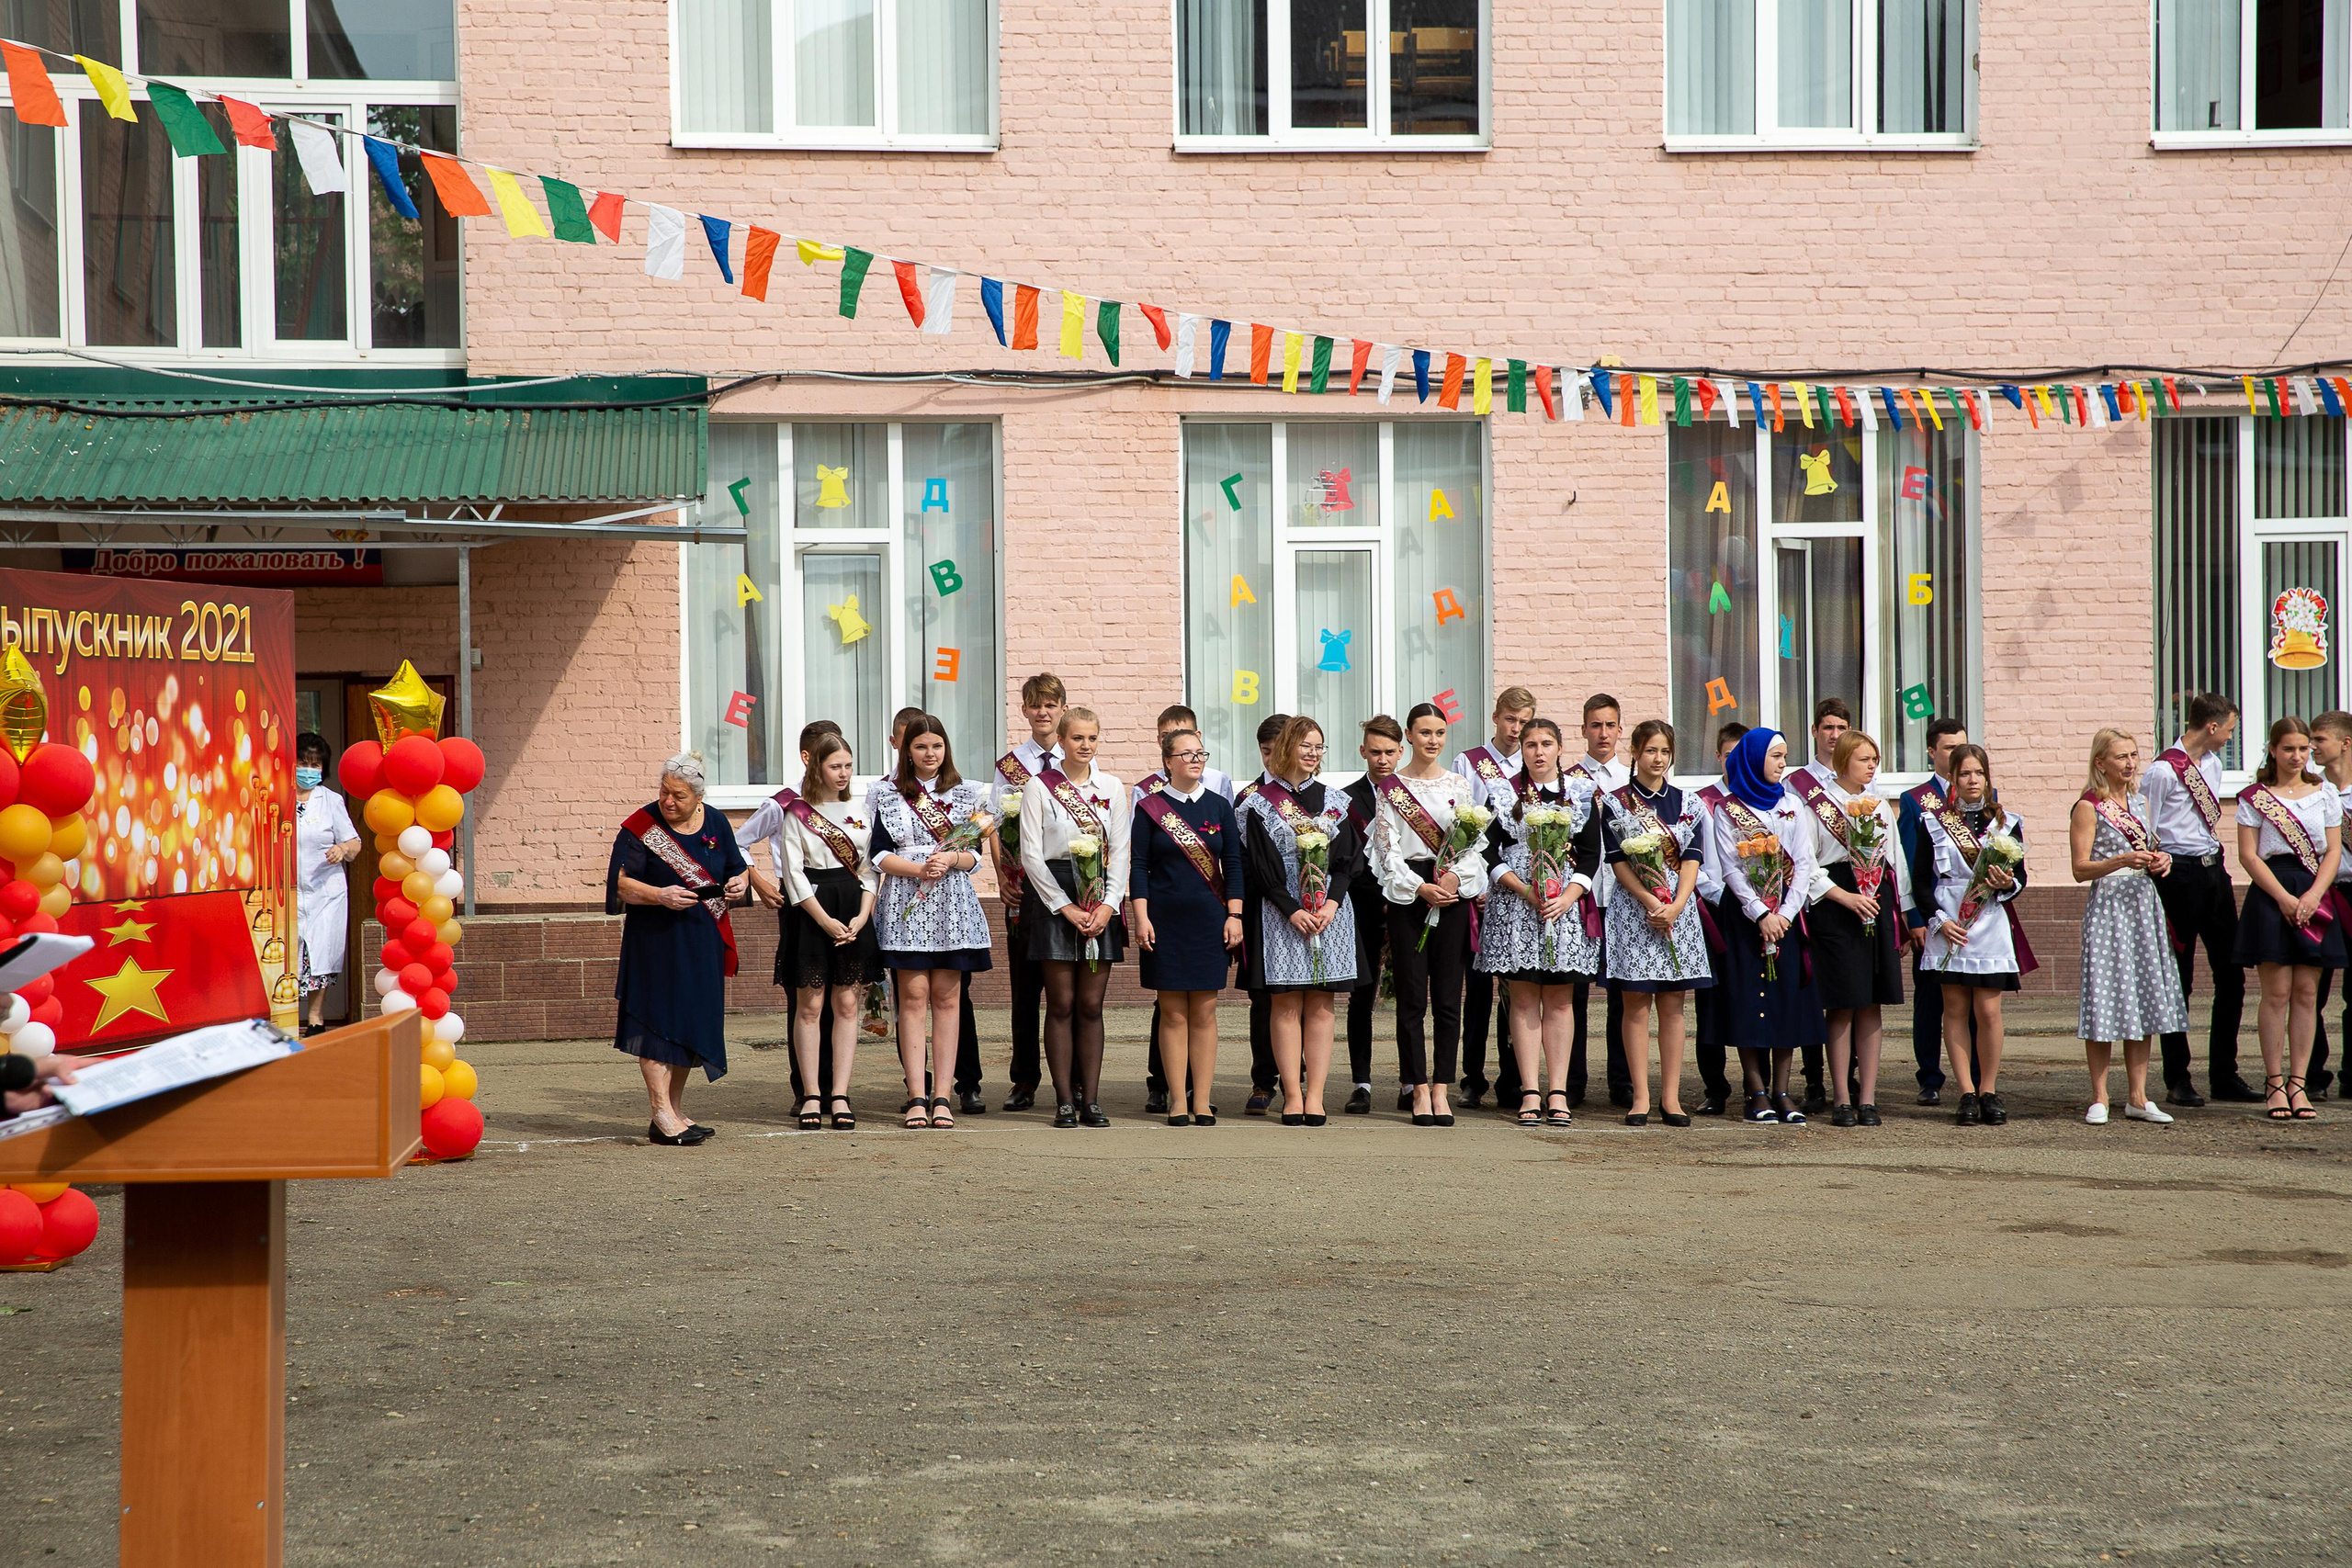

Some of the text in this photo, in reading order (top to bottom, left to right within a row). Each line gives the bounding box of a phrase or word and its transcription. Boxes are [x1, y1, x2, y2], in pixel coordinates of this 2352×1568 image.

[728, 477, 752, 516] Г
[922, 478, 949, 513] Д
[1220, 472, 1244, 512] Г
[1704, 480, 1732, 513] А
[1901, 465, 1928, 501] Е
[1429, 488, 1455, 523] А
[92, 547, 367, 575] Добро пожаловать !
[929, 558, 964, 597] В
[736, 572, 763, 608] А
[1230, 574, 1258, 608] А
[1432, 588, 1465, 626] Д
[1908, 573, 1933, 605] Б
[0, 600, 255, 675] ыпускник 2021
[1230, 669, 1260, 705] В
[1704, 676, 1737, 716] Д
[724, 690, 757, 728] Е
